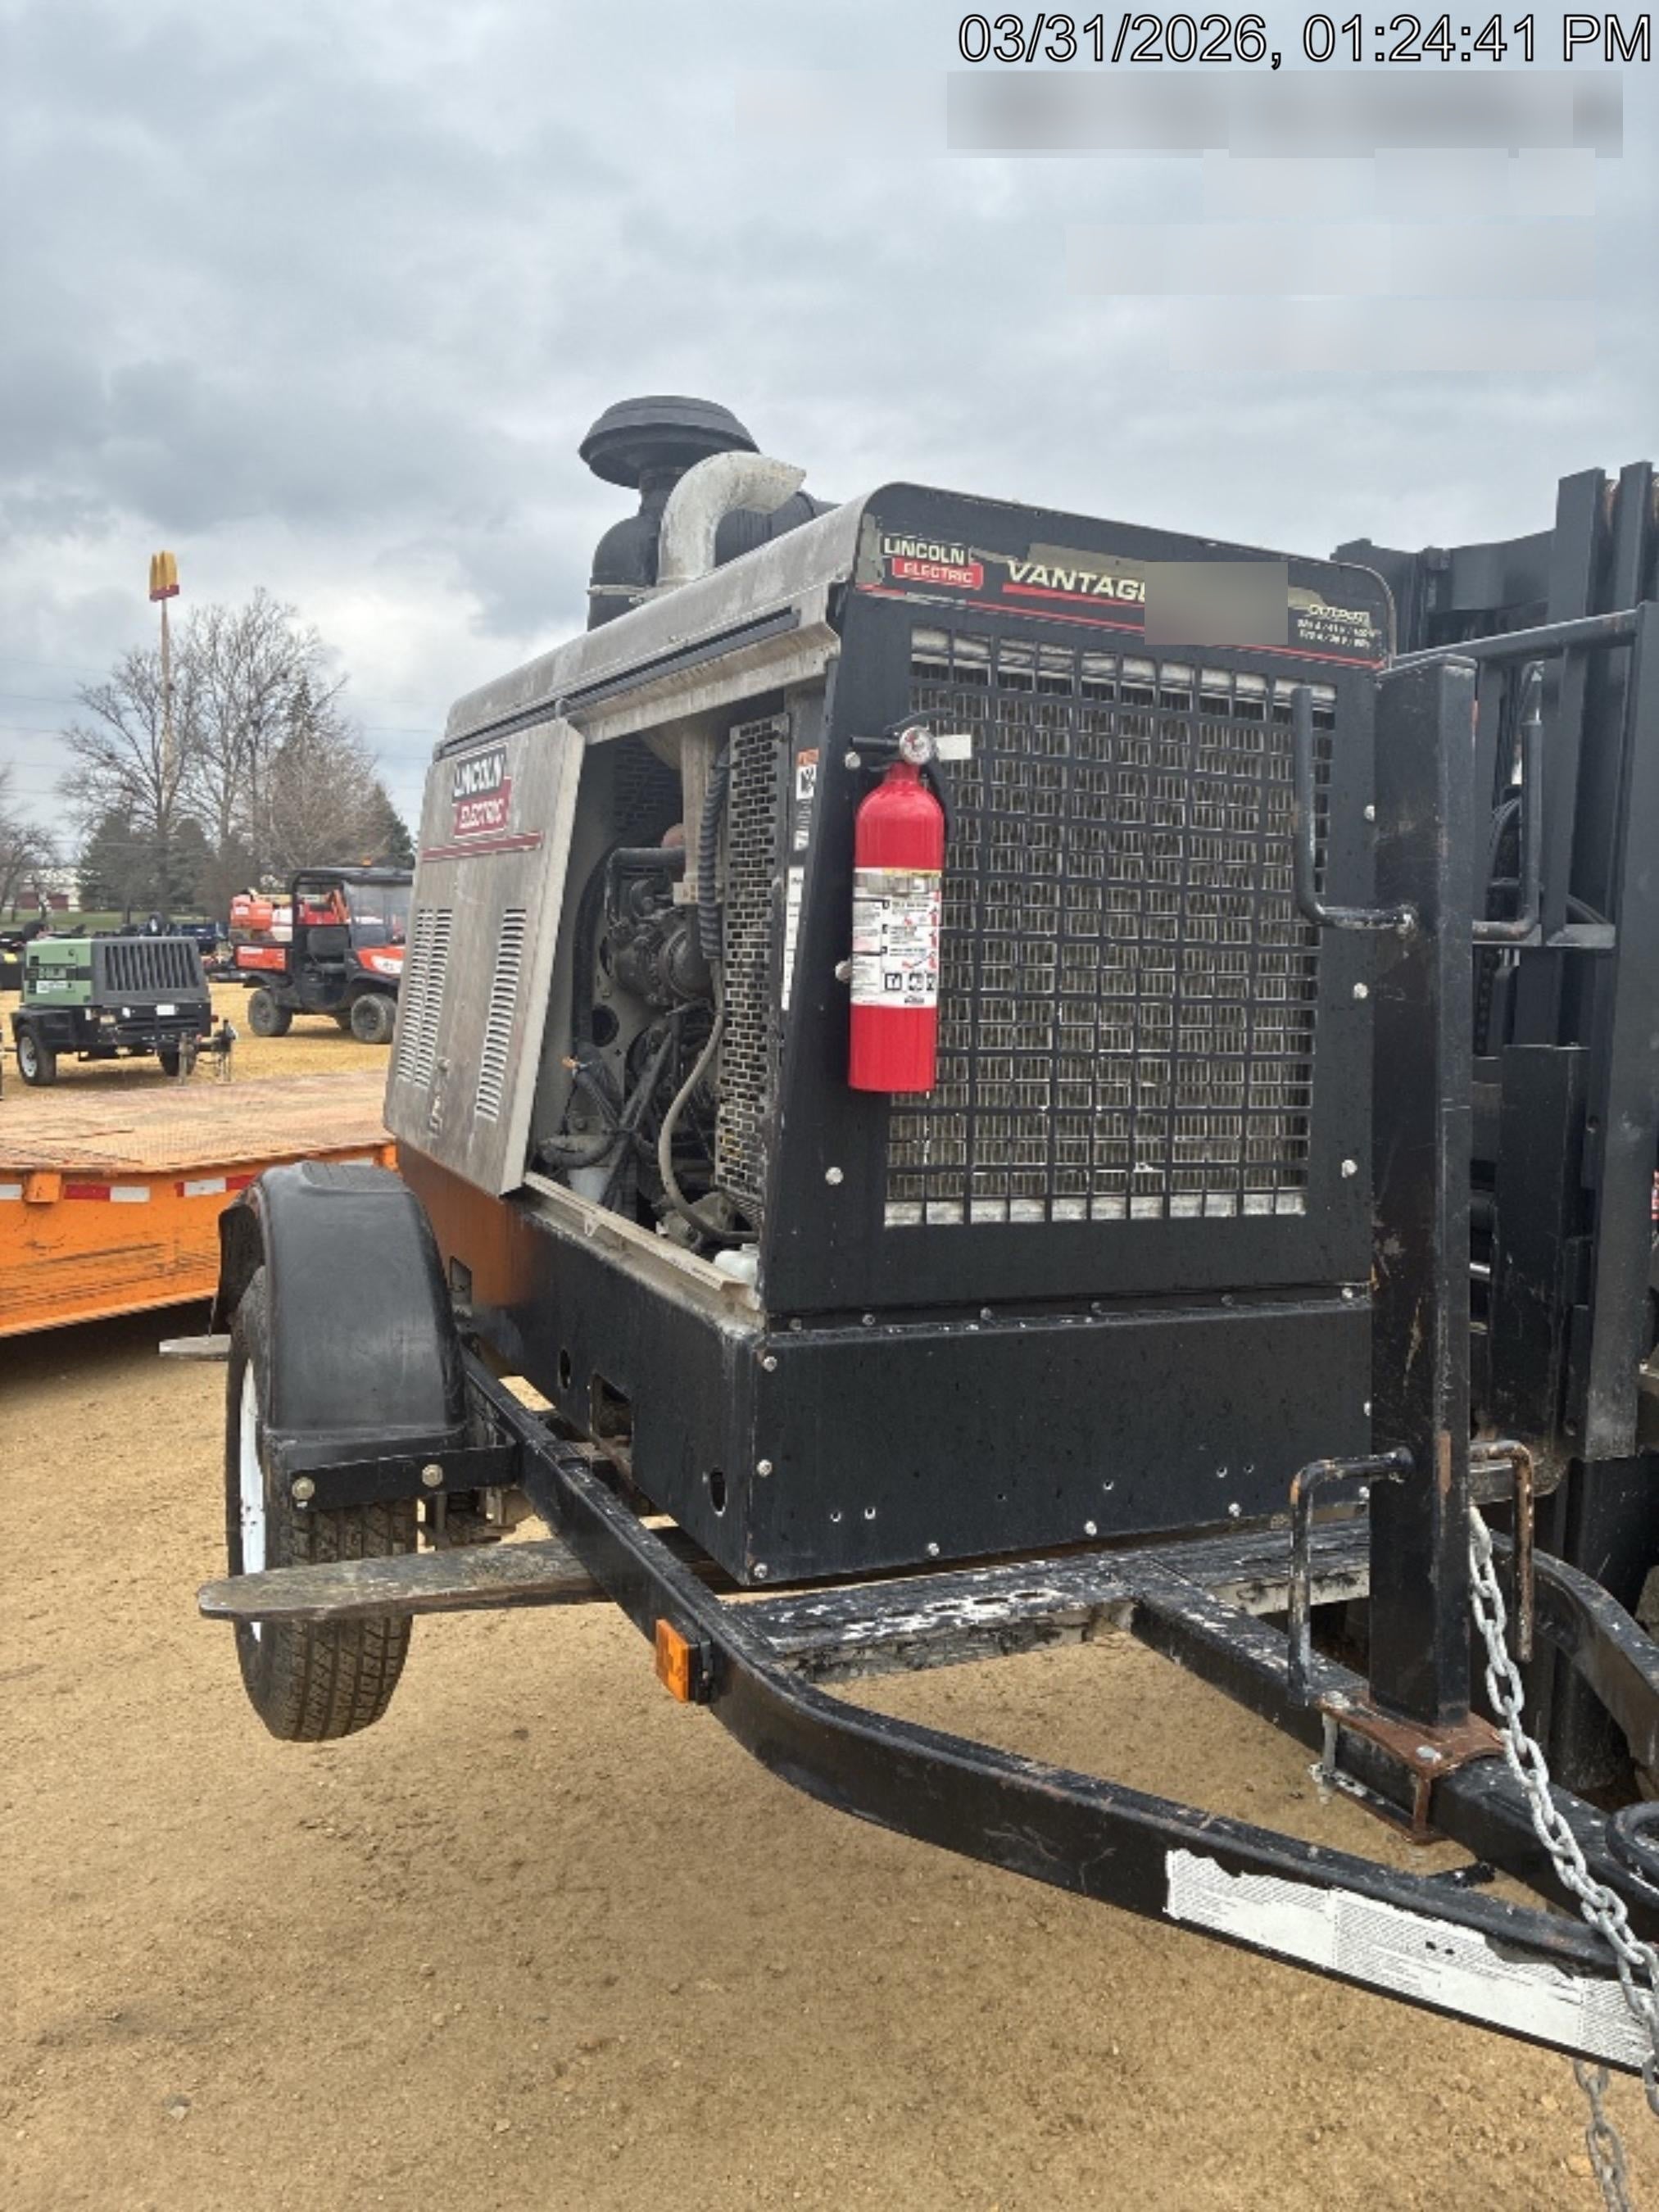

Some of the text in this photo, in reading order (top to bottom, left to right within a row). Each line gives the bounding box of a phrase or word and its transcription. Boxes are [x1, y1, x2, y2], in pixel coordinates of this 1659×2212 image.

[883, 537, 965, 566] LINCOLN
[903, 561, 973, 584] ELECTRIC
[1007, 560, 1145, 604] VANTAG
